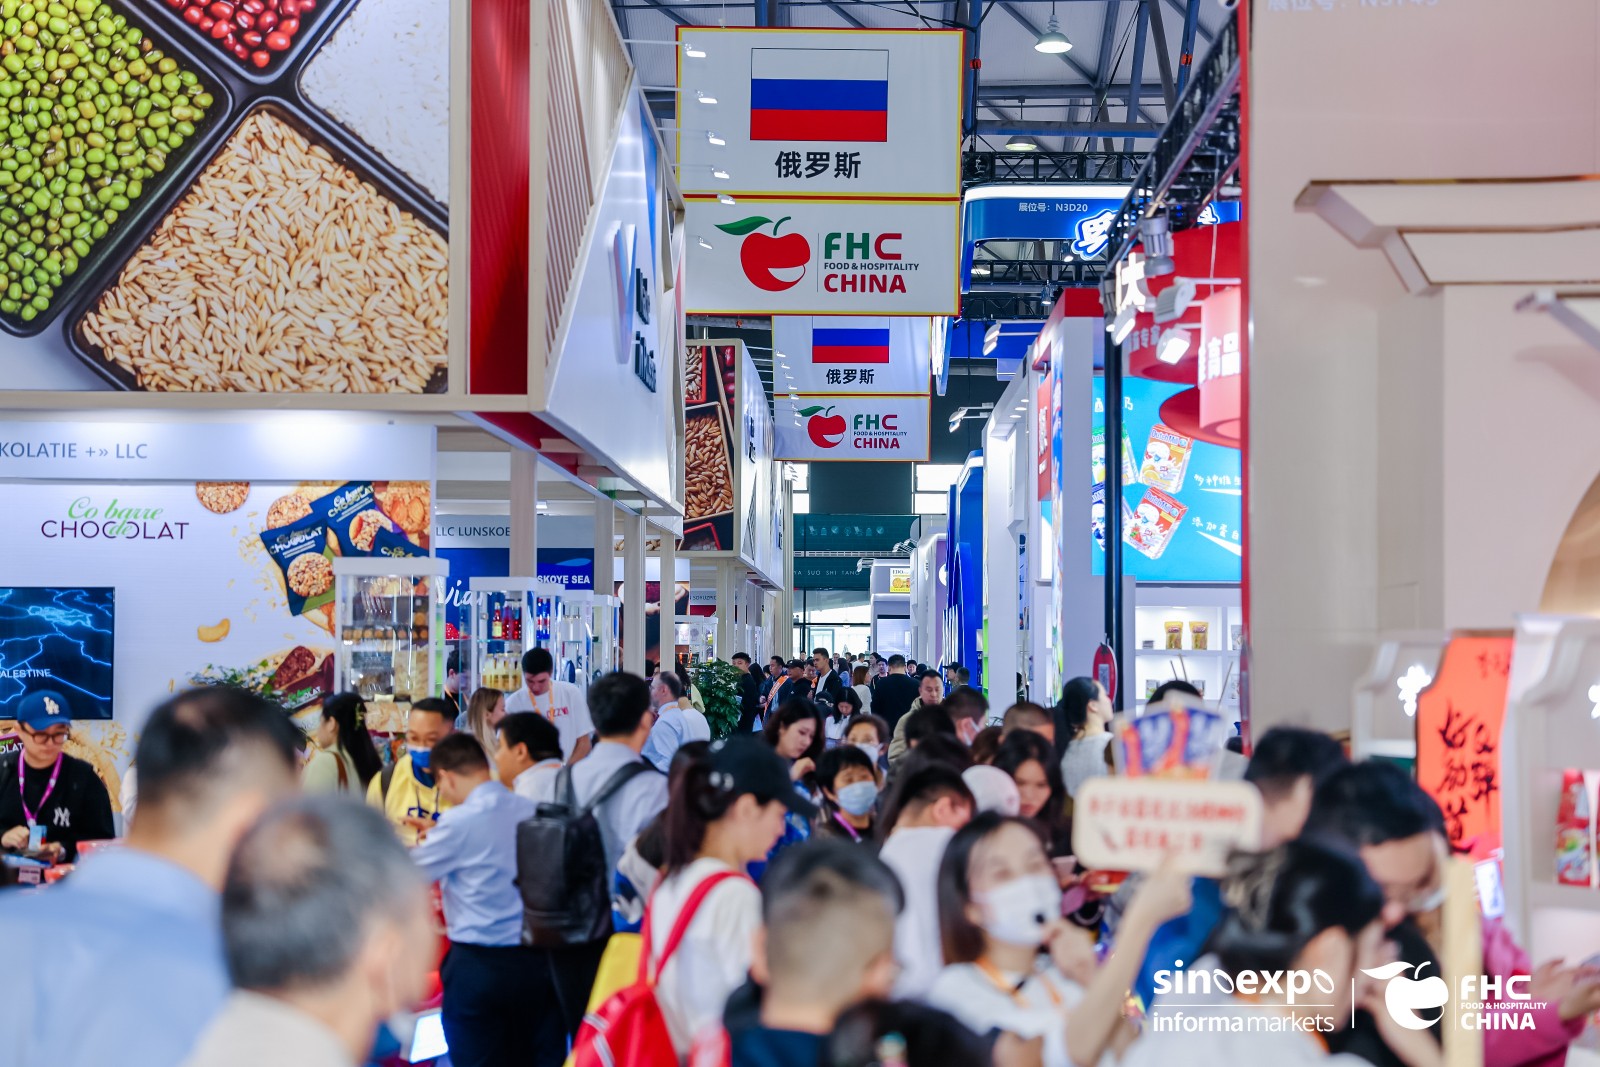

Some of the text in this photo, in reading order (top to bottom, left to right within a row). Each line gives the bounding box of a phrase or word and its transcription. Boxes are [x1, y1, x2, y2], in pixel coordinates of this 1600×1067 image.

[775, 151, 861, 179] 俄罗斯
[1055, 203, 1088, 212] N3D20
[824, 232, 902, 260] FHC
[824, 262, 850, 271] FOOD
[860, 263, 920, 271] HOSPITALITY
[824, 273, 907, 293] CHINA
[826, 369, 875, 385] 俄罗斯
[853, 414, 898, 430] FHC
[0, 442, 77, 458] KOLATIE
[116, 443, 148, 459] LLC
[853, 438, 900, 449] CHINA
[68, 496, 164, 520] Co barre
[41, 520, 189, 539] CHOCOLAT
[435, 527, 455, 536] LLC
[571, 575, 590, 584] SEA
[0, 668, 51, 679] ALESTINE
